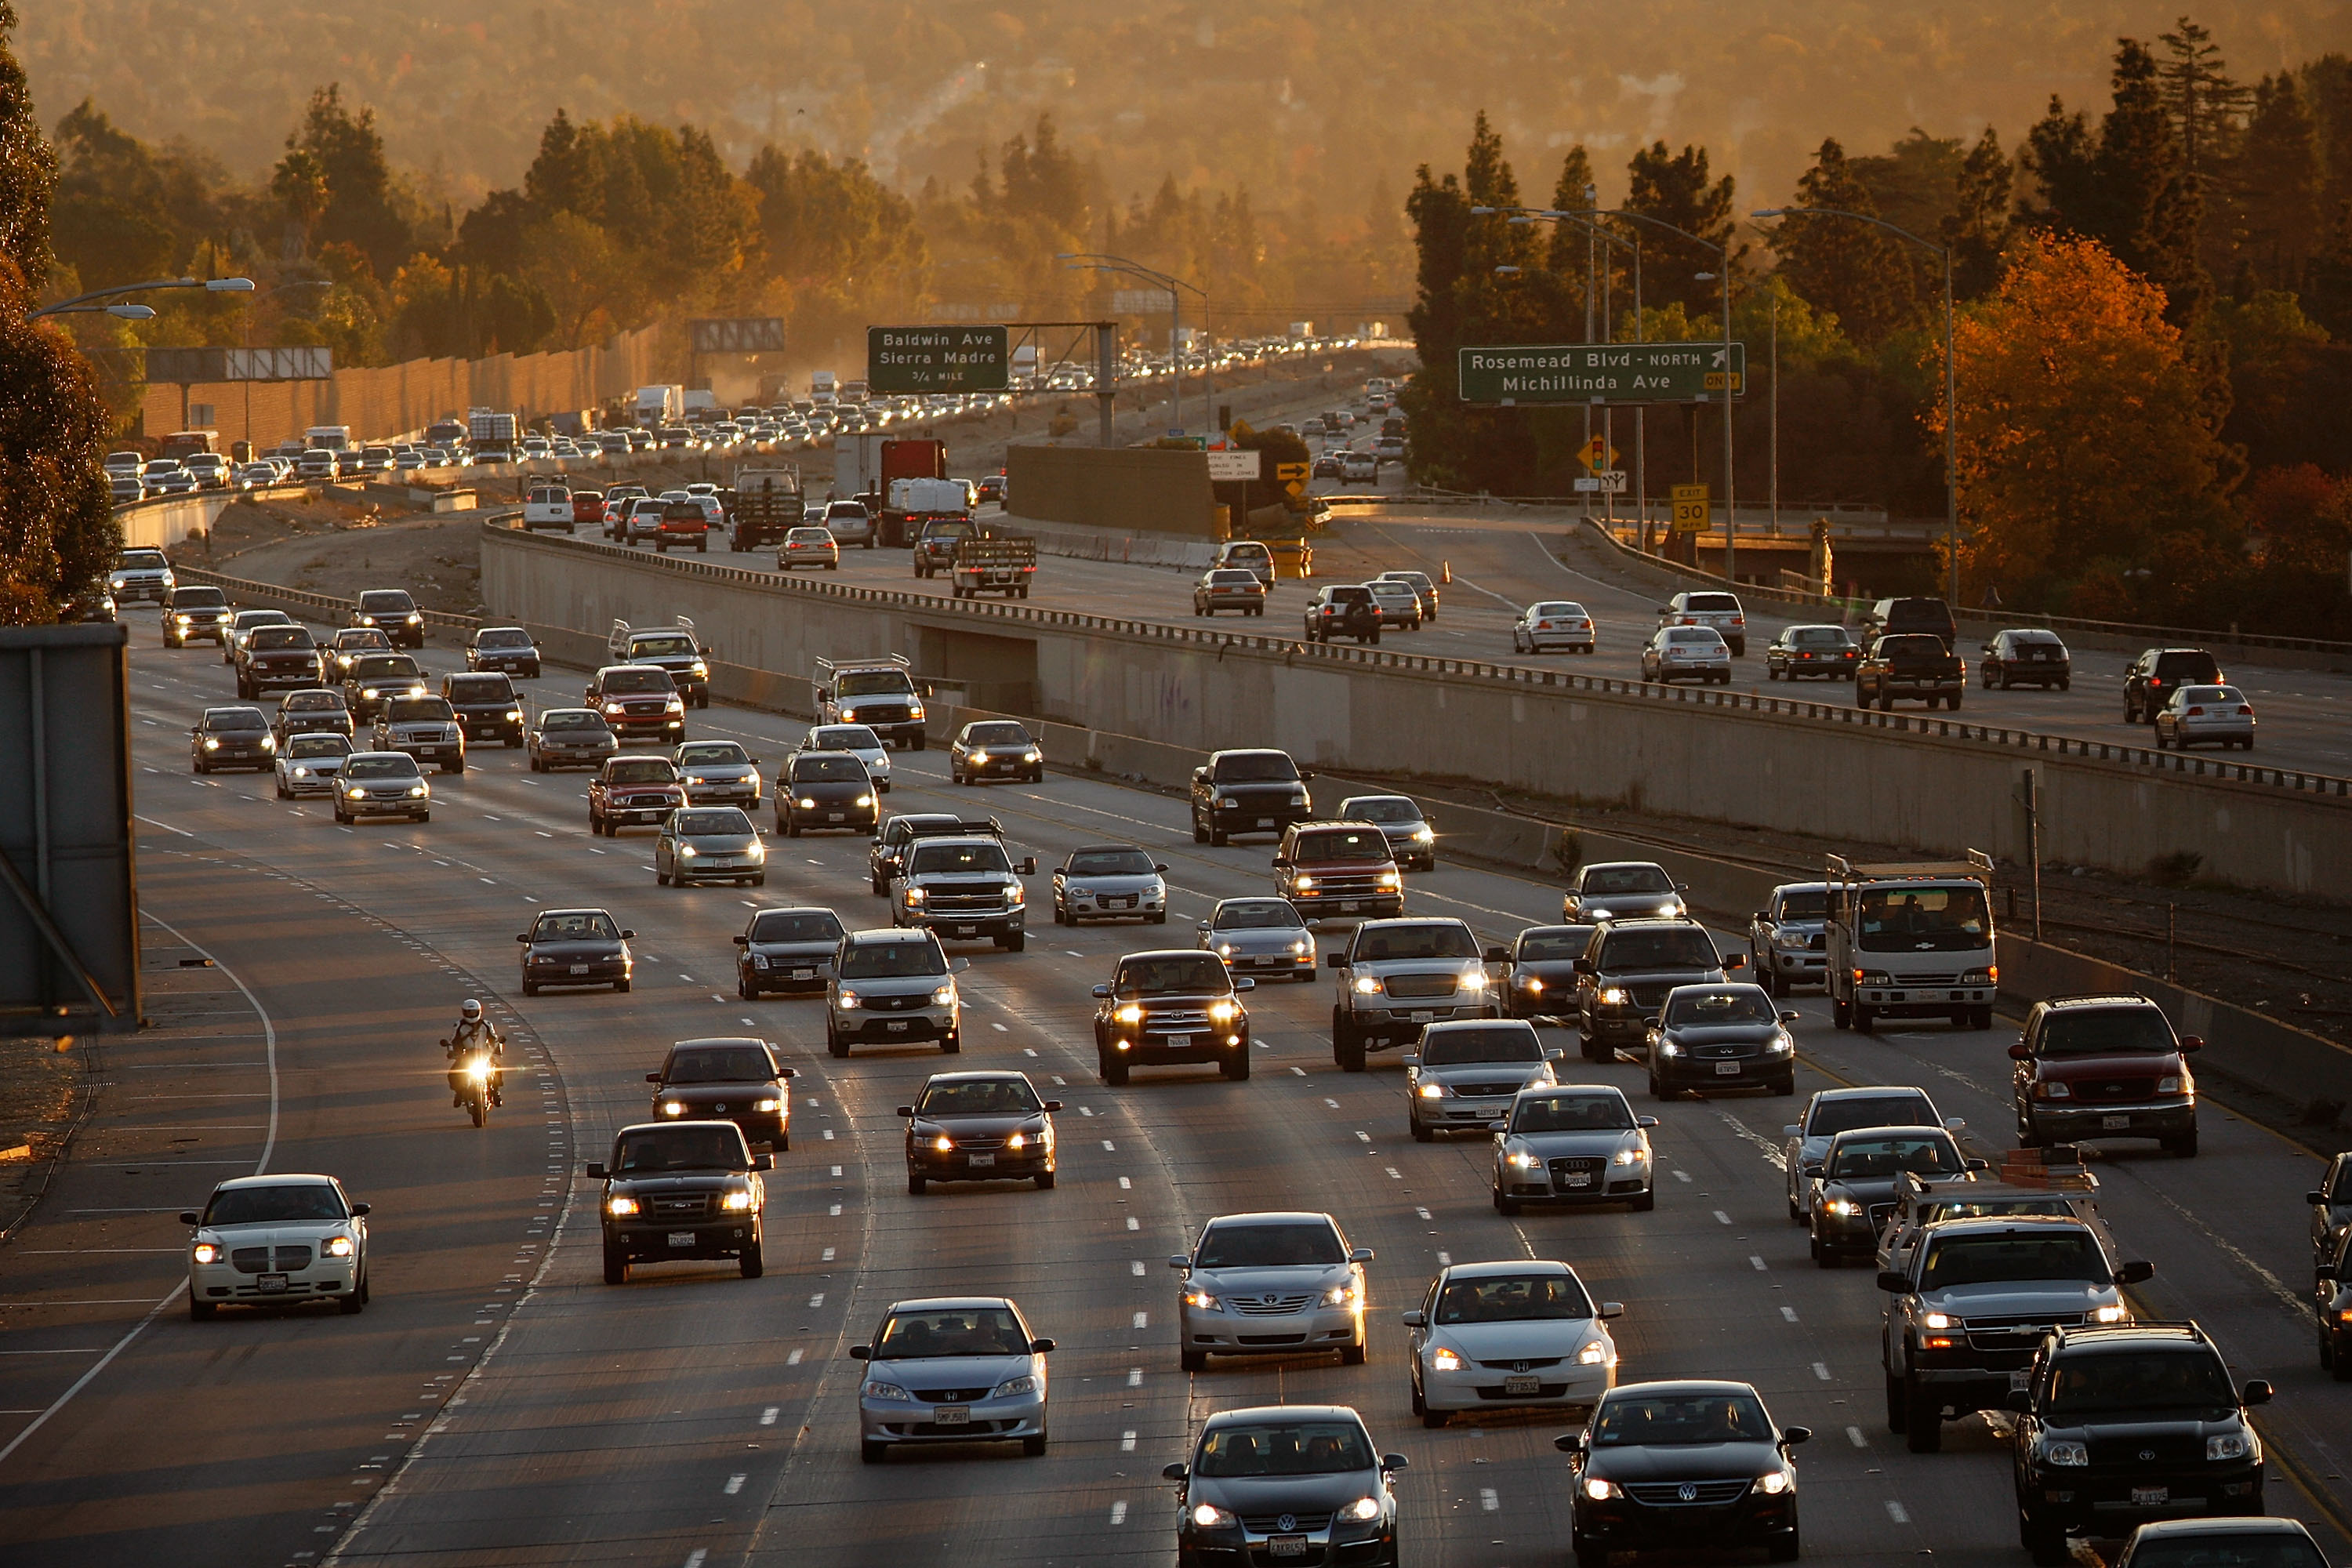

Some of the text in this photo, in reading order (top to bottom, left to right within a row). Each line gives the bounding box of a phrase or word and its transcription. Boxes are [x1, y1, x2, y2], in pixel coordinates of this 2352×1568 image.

[884, 333, 993, 347] Baldwin Ave
[880, 351, 996, 365] Sierra Madre
[1472, 354, 1571, 369] Rosemead
[1587, 353, 1630, 367] Blvd
[1650, 354, 1700, 366] NORTH
[912, 371, 964, 383] 3/4 MILE
[1504, 375, 1671, 391] Michillinda Ave
[1706, 376, 1737, 386] ONY
[1679, 488, 1700, 498] EXIT
[1679, 504, 1703, 520] 30
